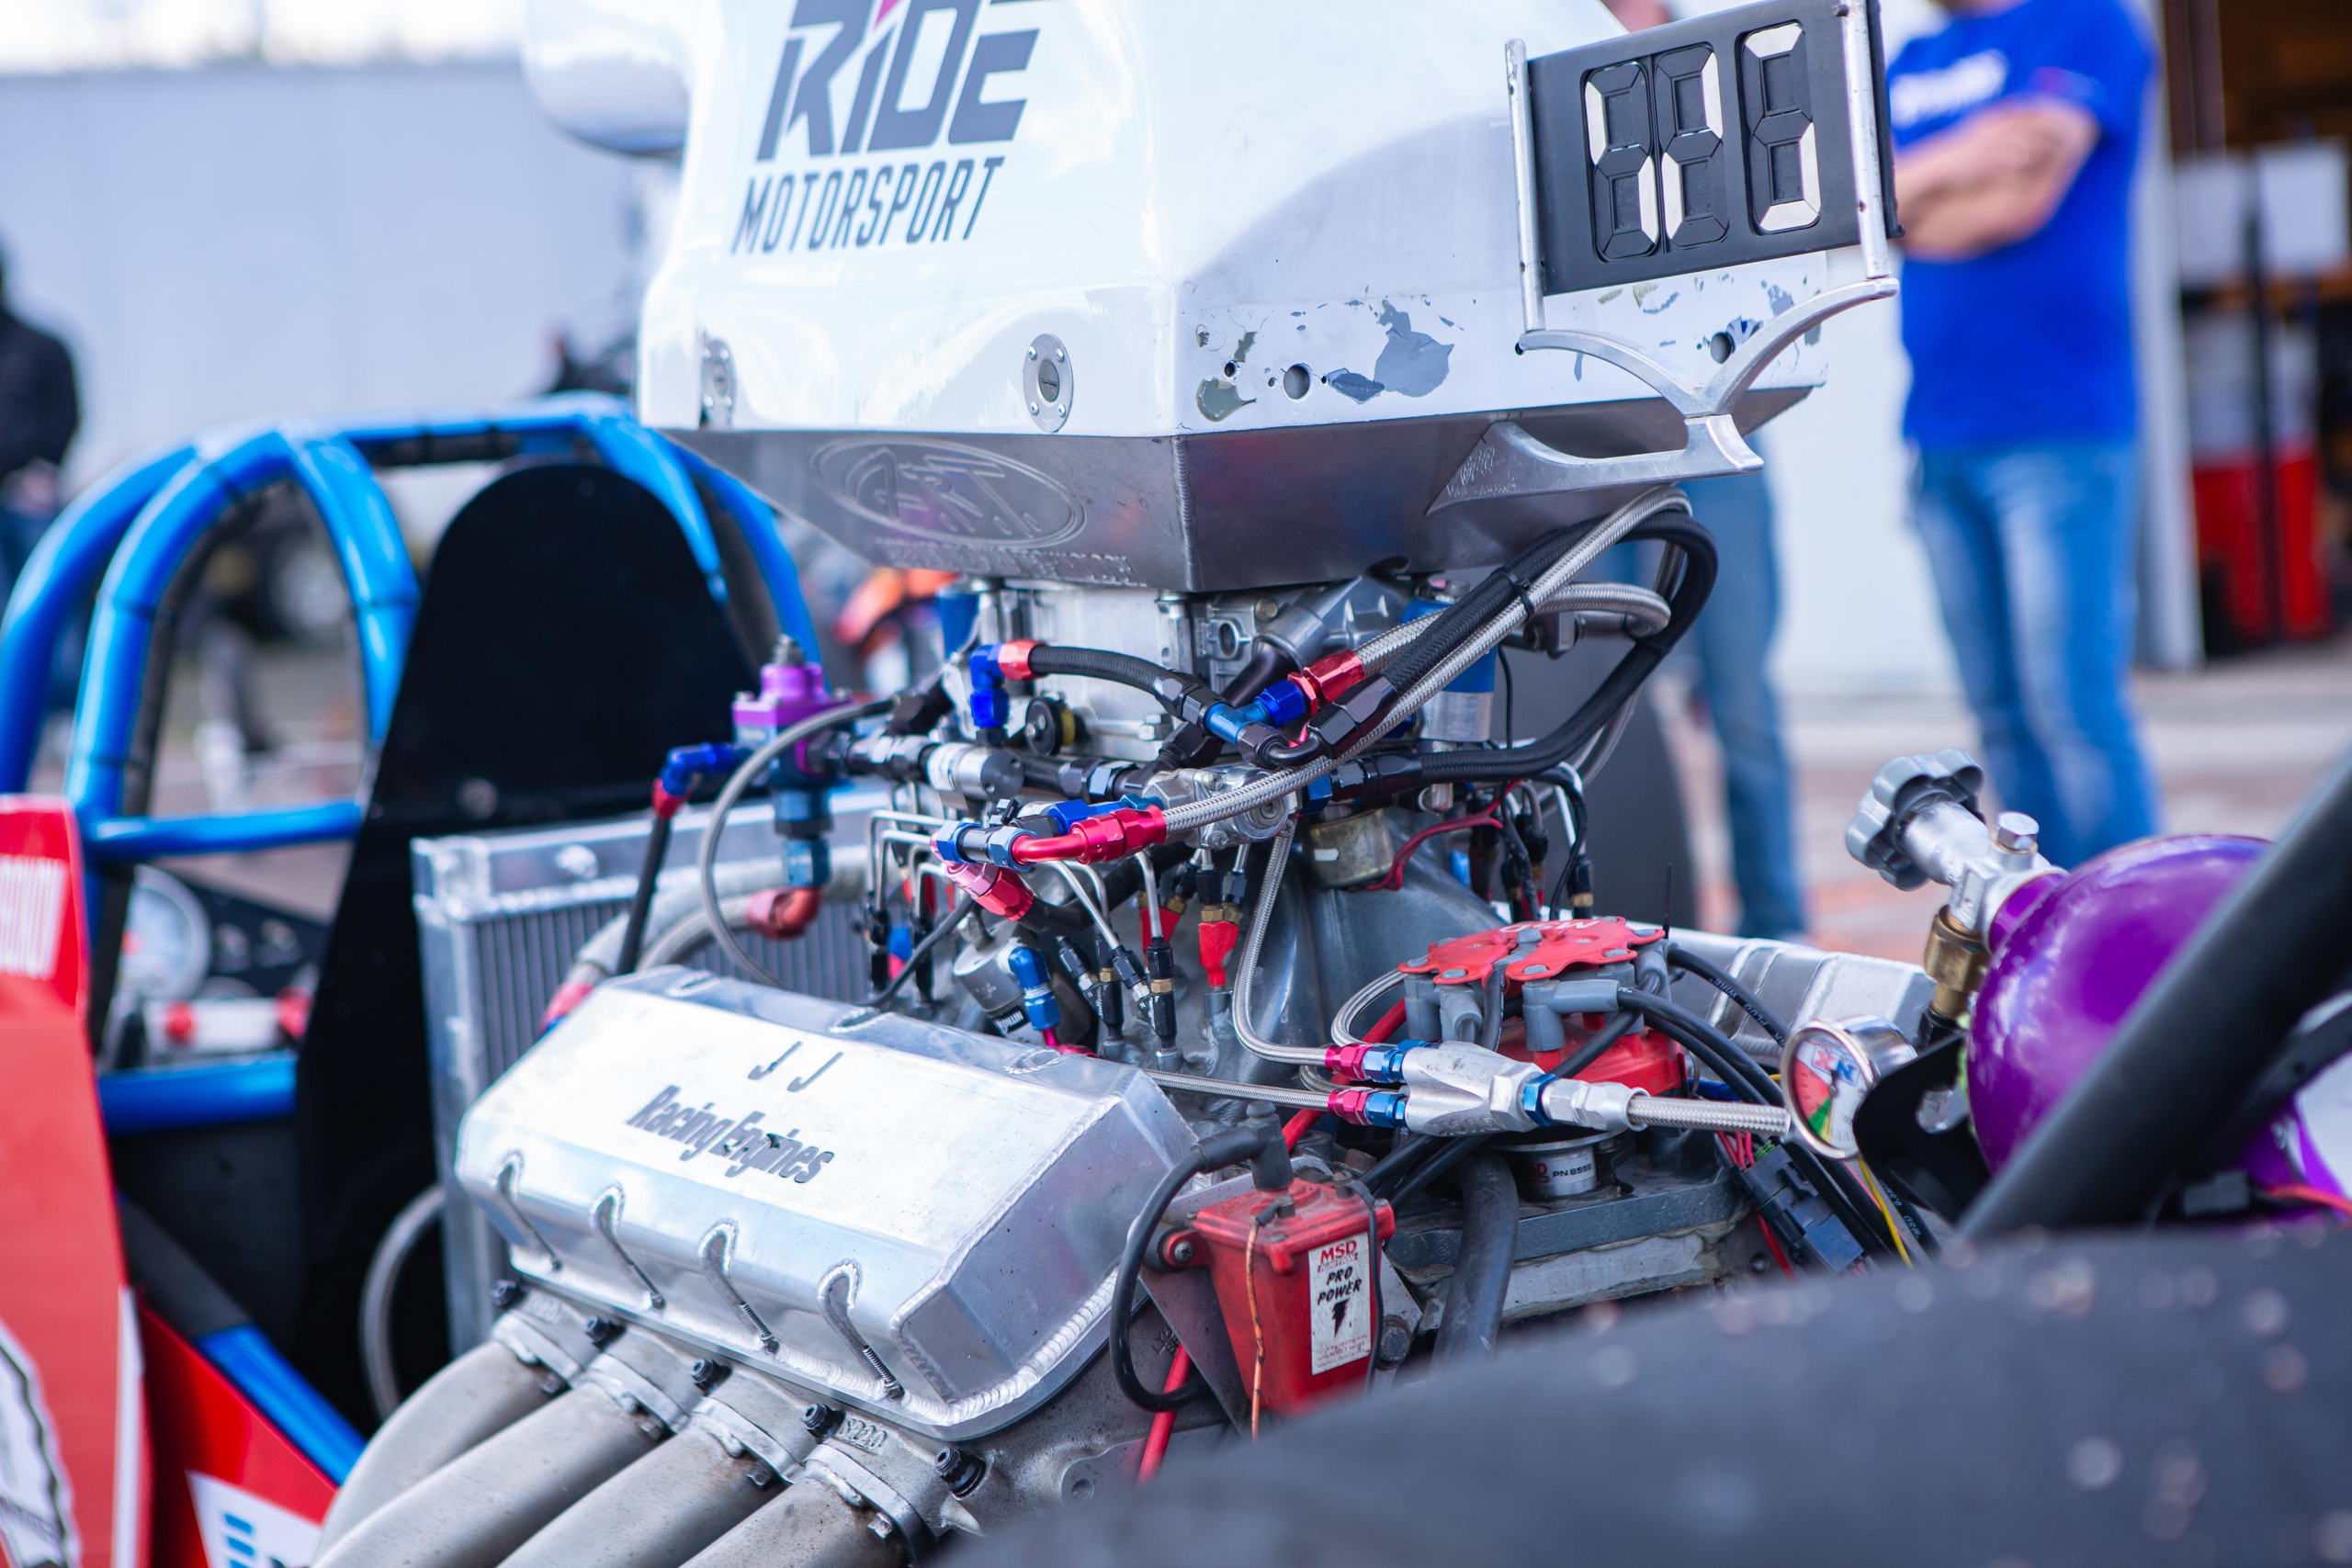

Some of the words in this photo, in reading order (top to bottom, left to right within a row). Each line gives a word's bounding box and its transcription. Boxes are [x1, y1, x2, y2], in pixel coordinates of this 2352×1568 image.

[755, 0, 1044, 163] RIDE
[730, 156, 1006, 255] MOTORSPORT
[626, 1085, 735, 1161] Racing
[708, 1111, 834, 1183] Engines
[1320, 1240, 1358, 1264] MSD
[1327, 1266, 1353, 1286] PRO
[1317, 1279, 1362, 1305] POWER
